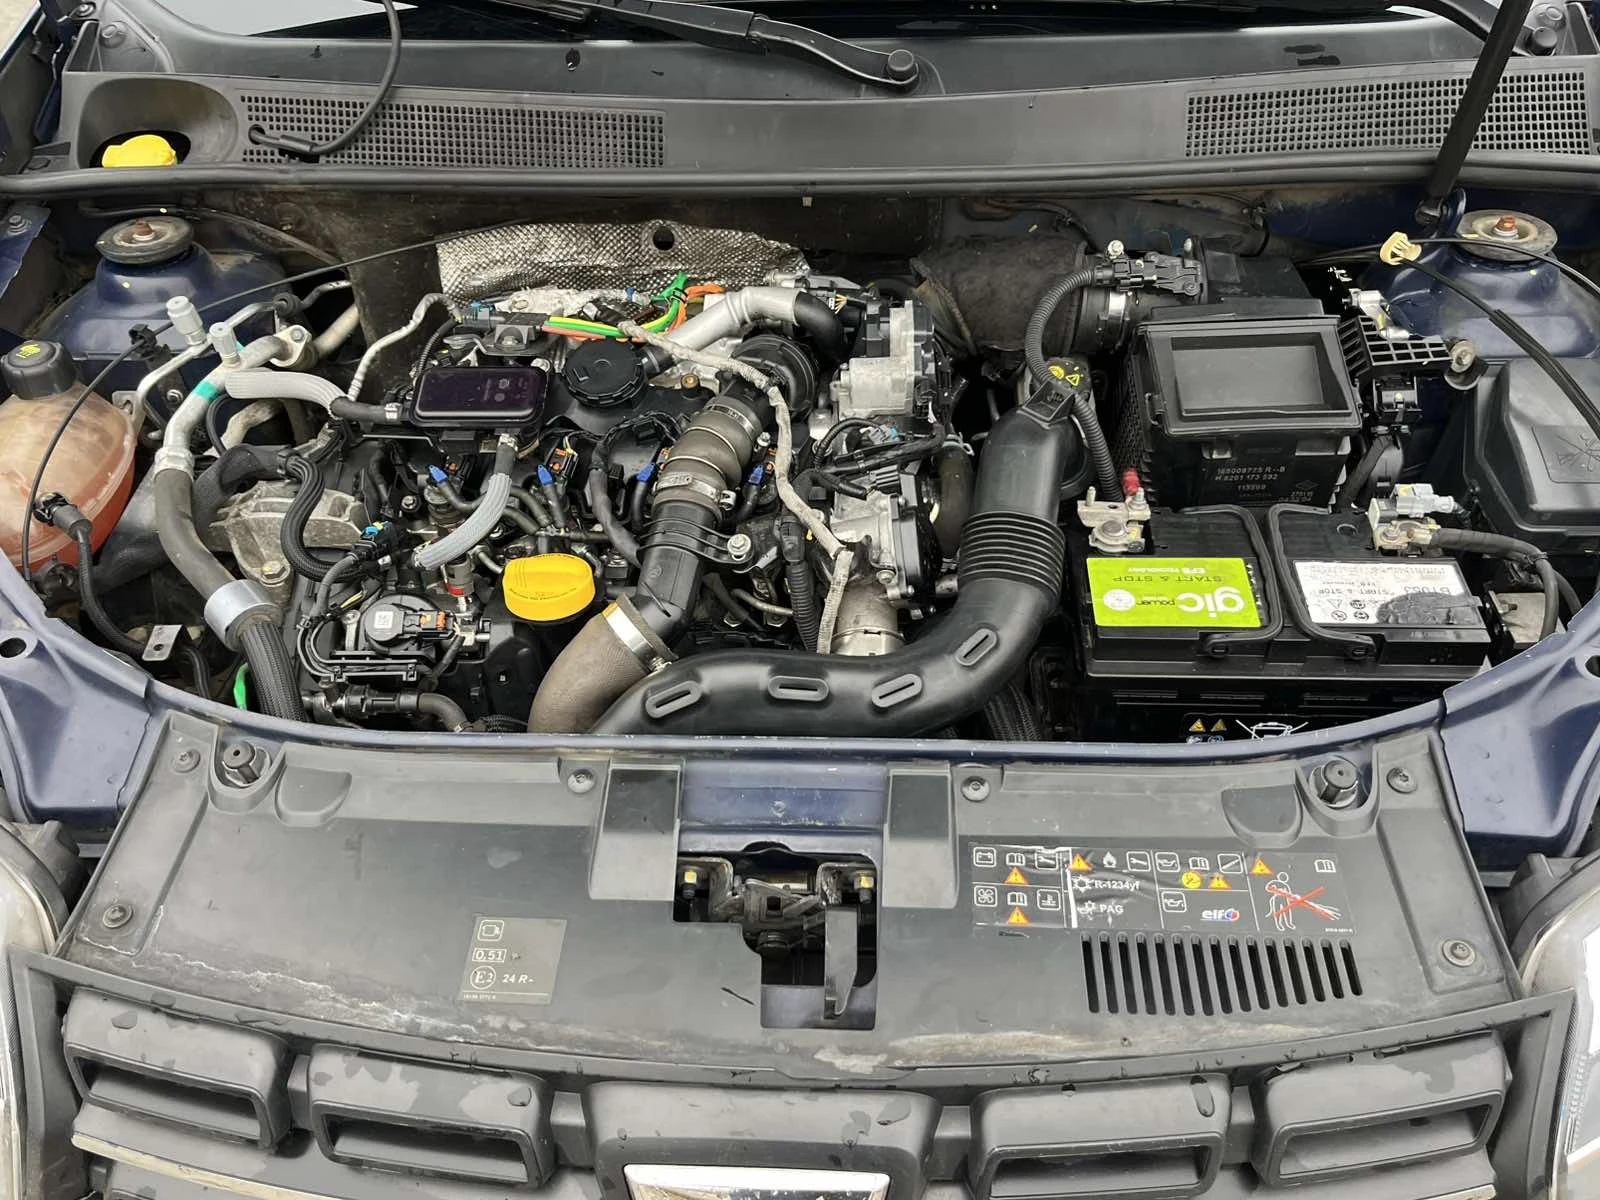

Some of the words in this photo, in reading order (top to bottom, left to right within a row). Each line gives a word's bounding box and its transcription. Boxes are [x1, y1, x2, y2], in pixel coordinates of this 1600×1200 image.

[1176, 575, 1222, 583] START
[1176, 585, 1246, 618] gic
[1094, 879, 1141, 892] R-1234yf
[1099, 903, 1125, 914] PAG
[1201, 909, 1225, 920] elf
[475, 950, 503, 961] 0.51
[502, 974, 516, 983] 24
